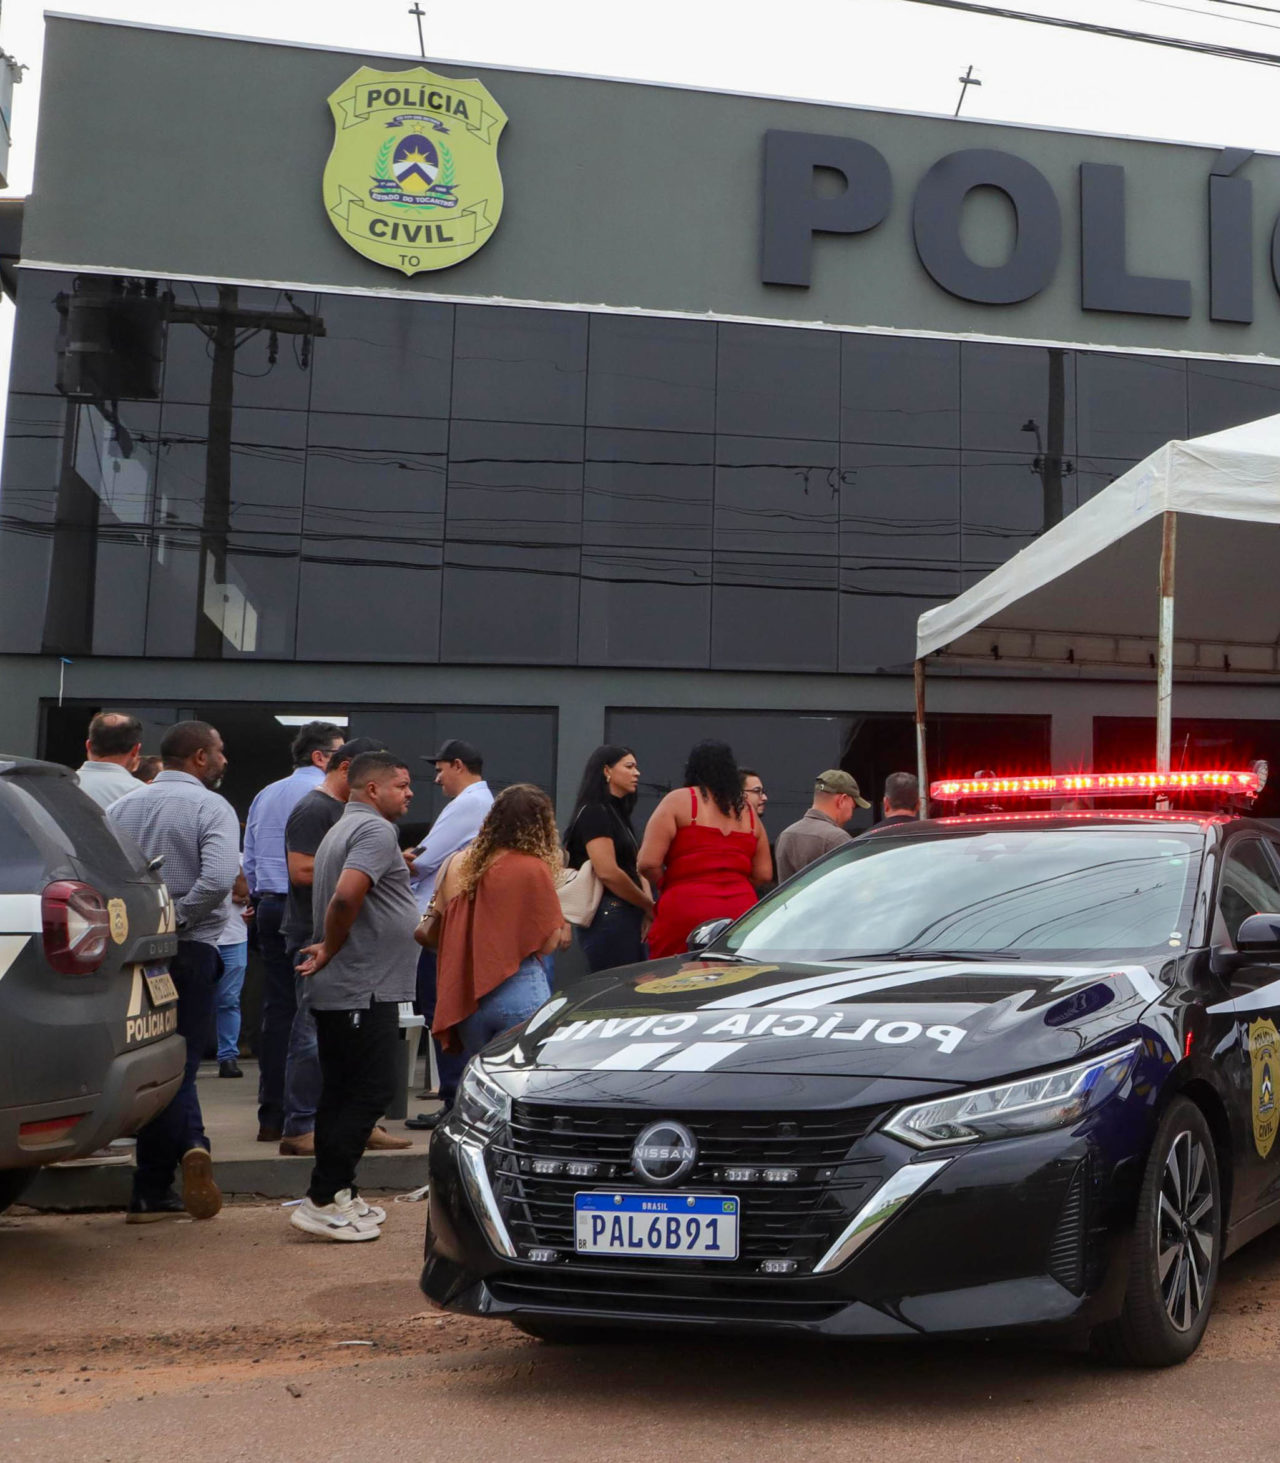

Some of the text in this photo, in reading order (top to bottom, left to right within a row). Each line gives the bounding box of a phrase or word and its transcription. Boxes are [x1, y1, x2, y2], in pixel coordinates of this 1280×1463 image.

[367, 85, 469, 119] POLÍCIA
[402, 195, 413, 203] DO
[369, 218, 454, 244] CIVIL
[398, 254, 421, 267] TO
[126, 1010, 164, 1043] POLÍCIA
[634, 1148, 694, 1159] NISSAN
[642, 1202, 668, 1211] BRASIL
[591, 1215, 720, 1250] PAL6B91
[578, 1239, 587, 1249] BR
